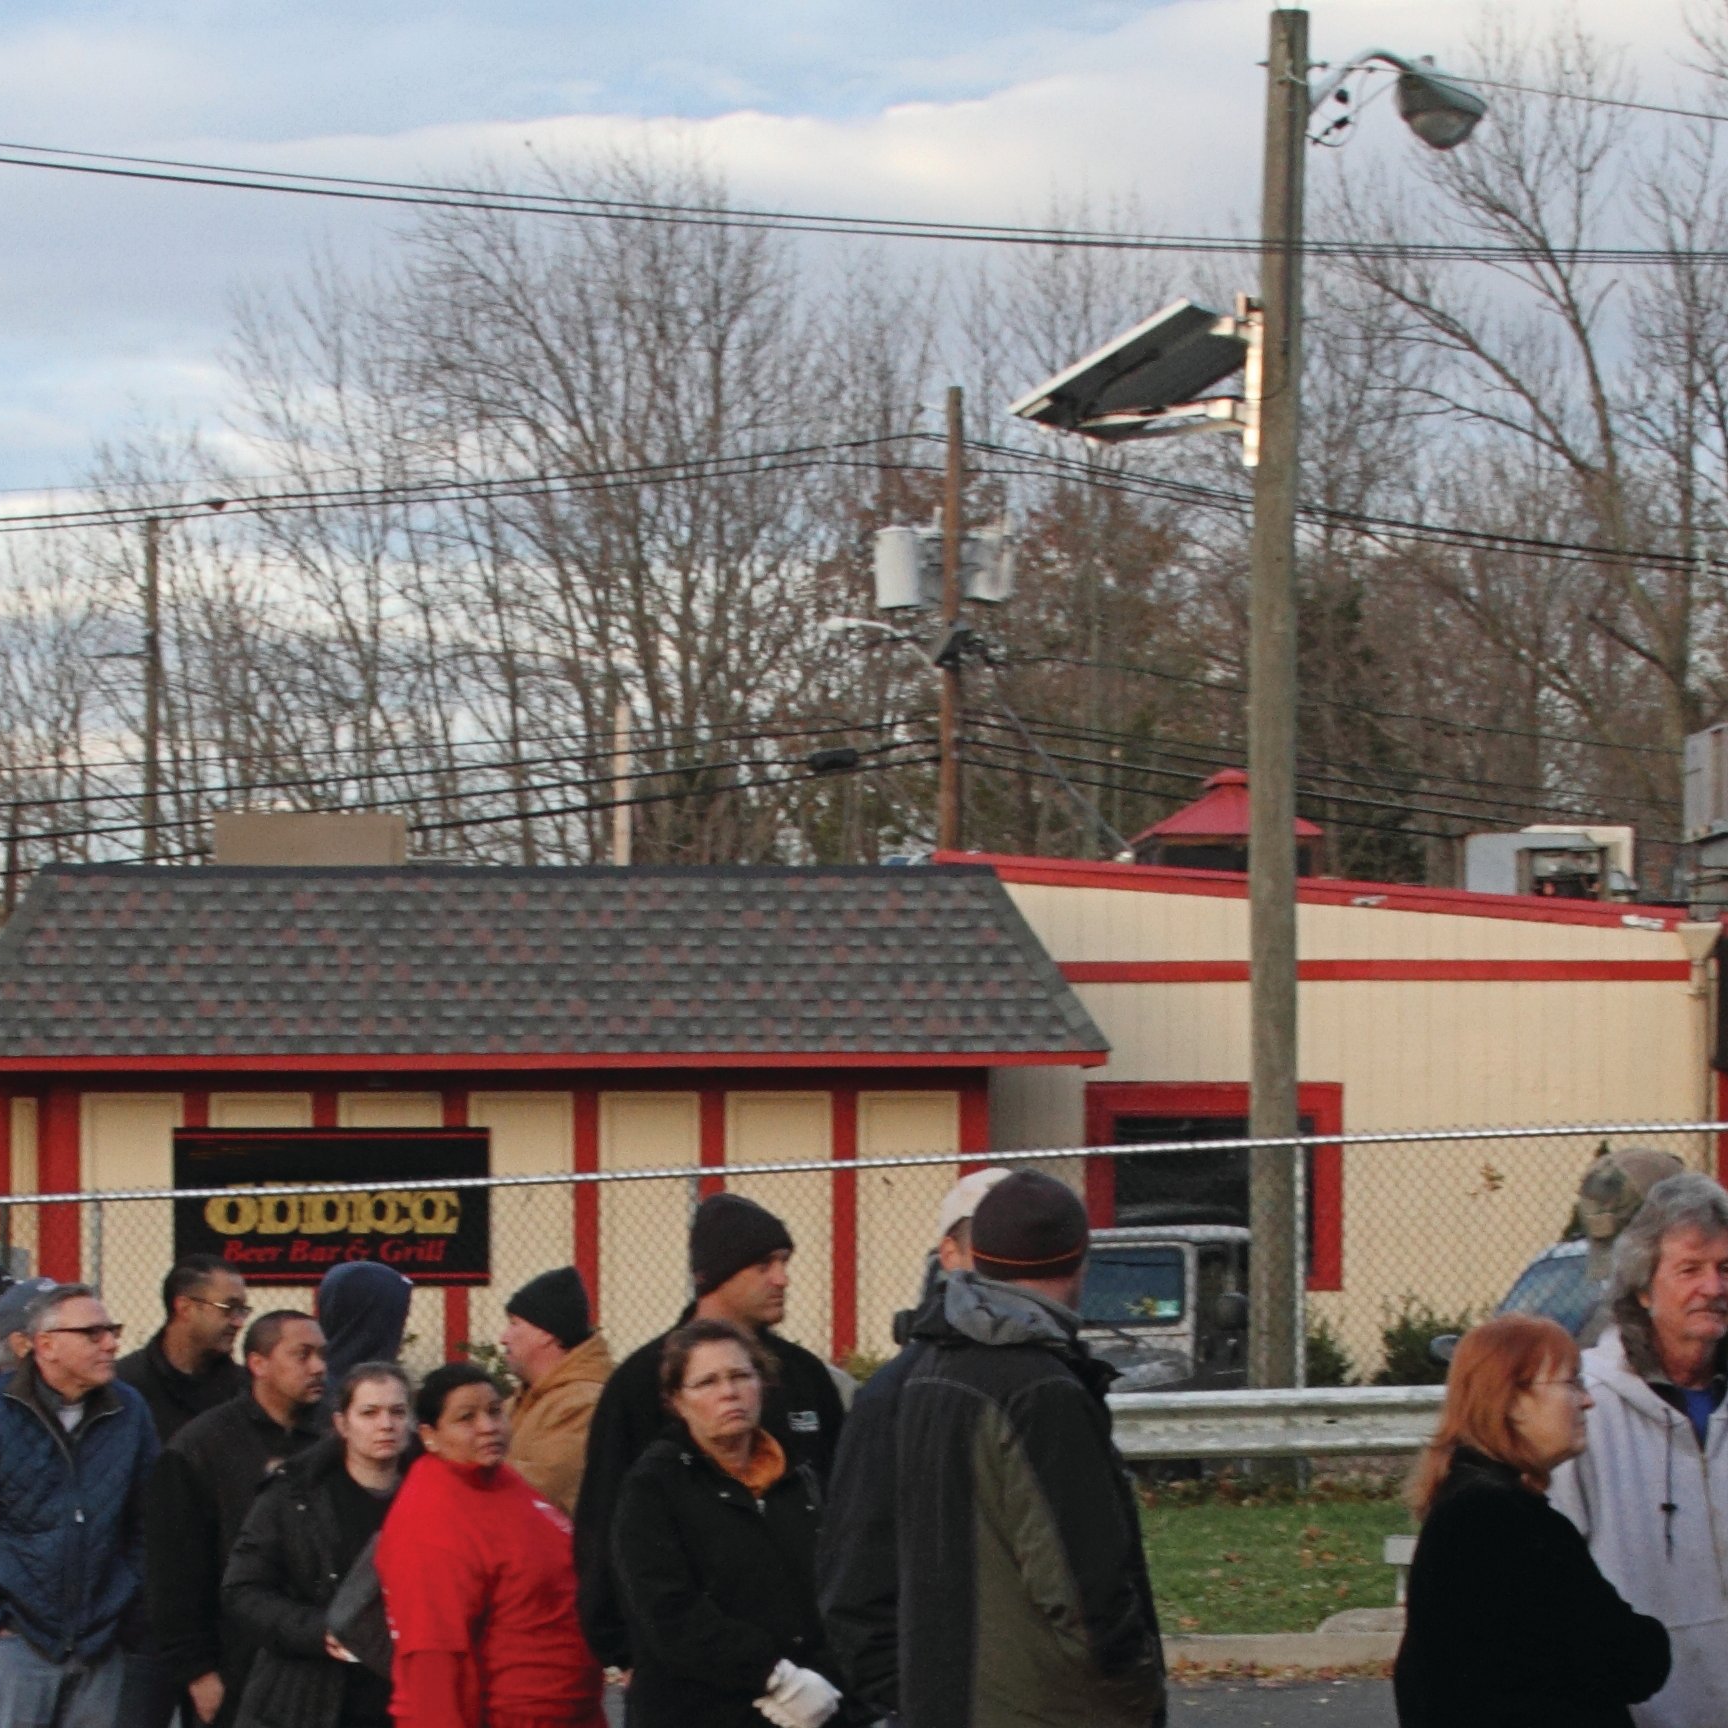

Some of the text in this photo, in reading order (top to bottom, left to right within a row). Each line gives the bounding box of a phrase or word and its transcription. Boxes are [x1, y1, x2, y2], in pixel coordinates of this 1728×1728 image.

[223, 1238, 448, 1262] Beer Bar & Grill
